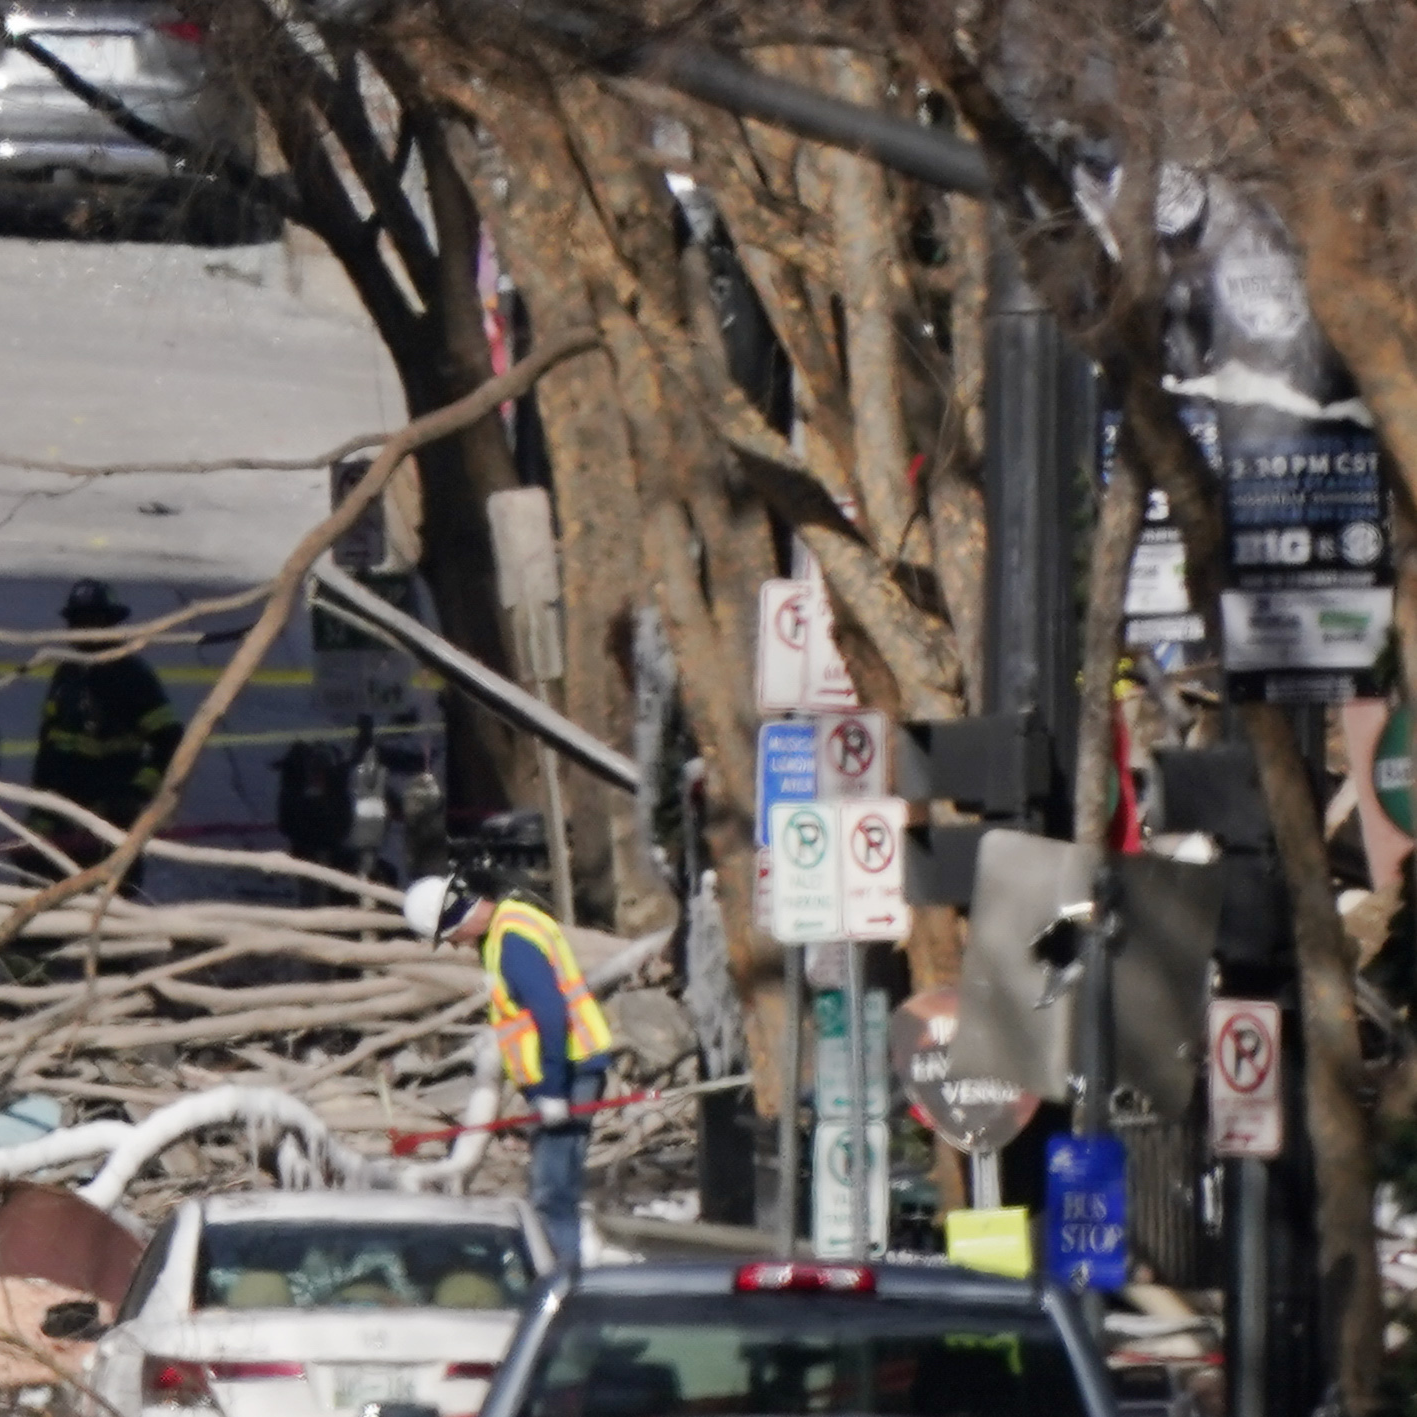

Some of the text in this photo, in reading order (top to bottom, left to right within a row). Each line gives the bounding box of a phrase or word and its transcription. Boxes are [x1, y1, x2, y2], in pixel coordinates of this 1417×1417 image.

[1292, 453, 1329, 474] PM
[1334, 452, 1379, 474] CST
[1064, 1192, 1107, 1220] BUS
[1062, 1223, 1123, 1253] STOP
